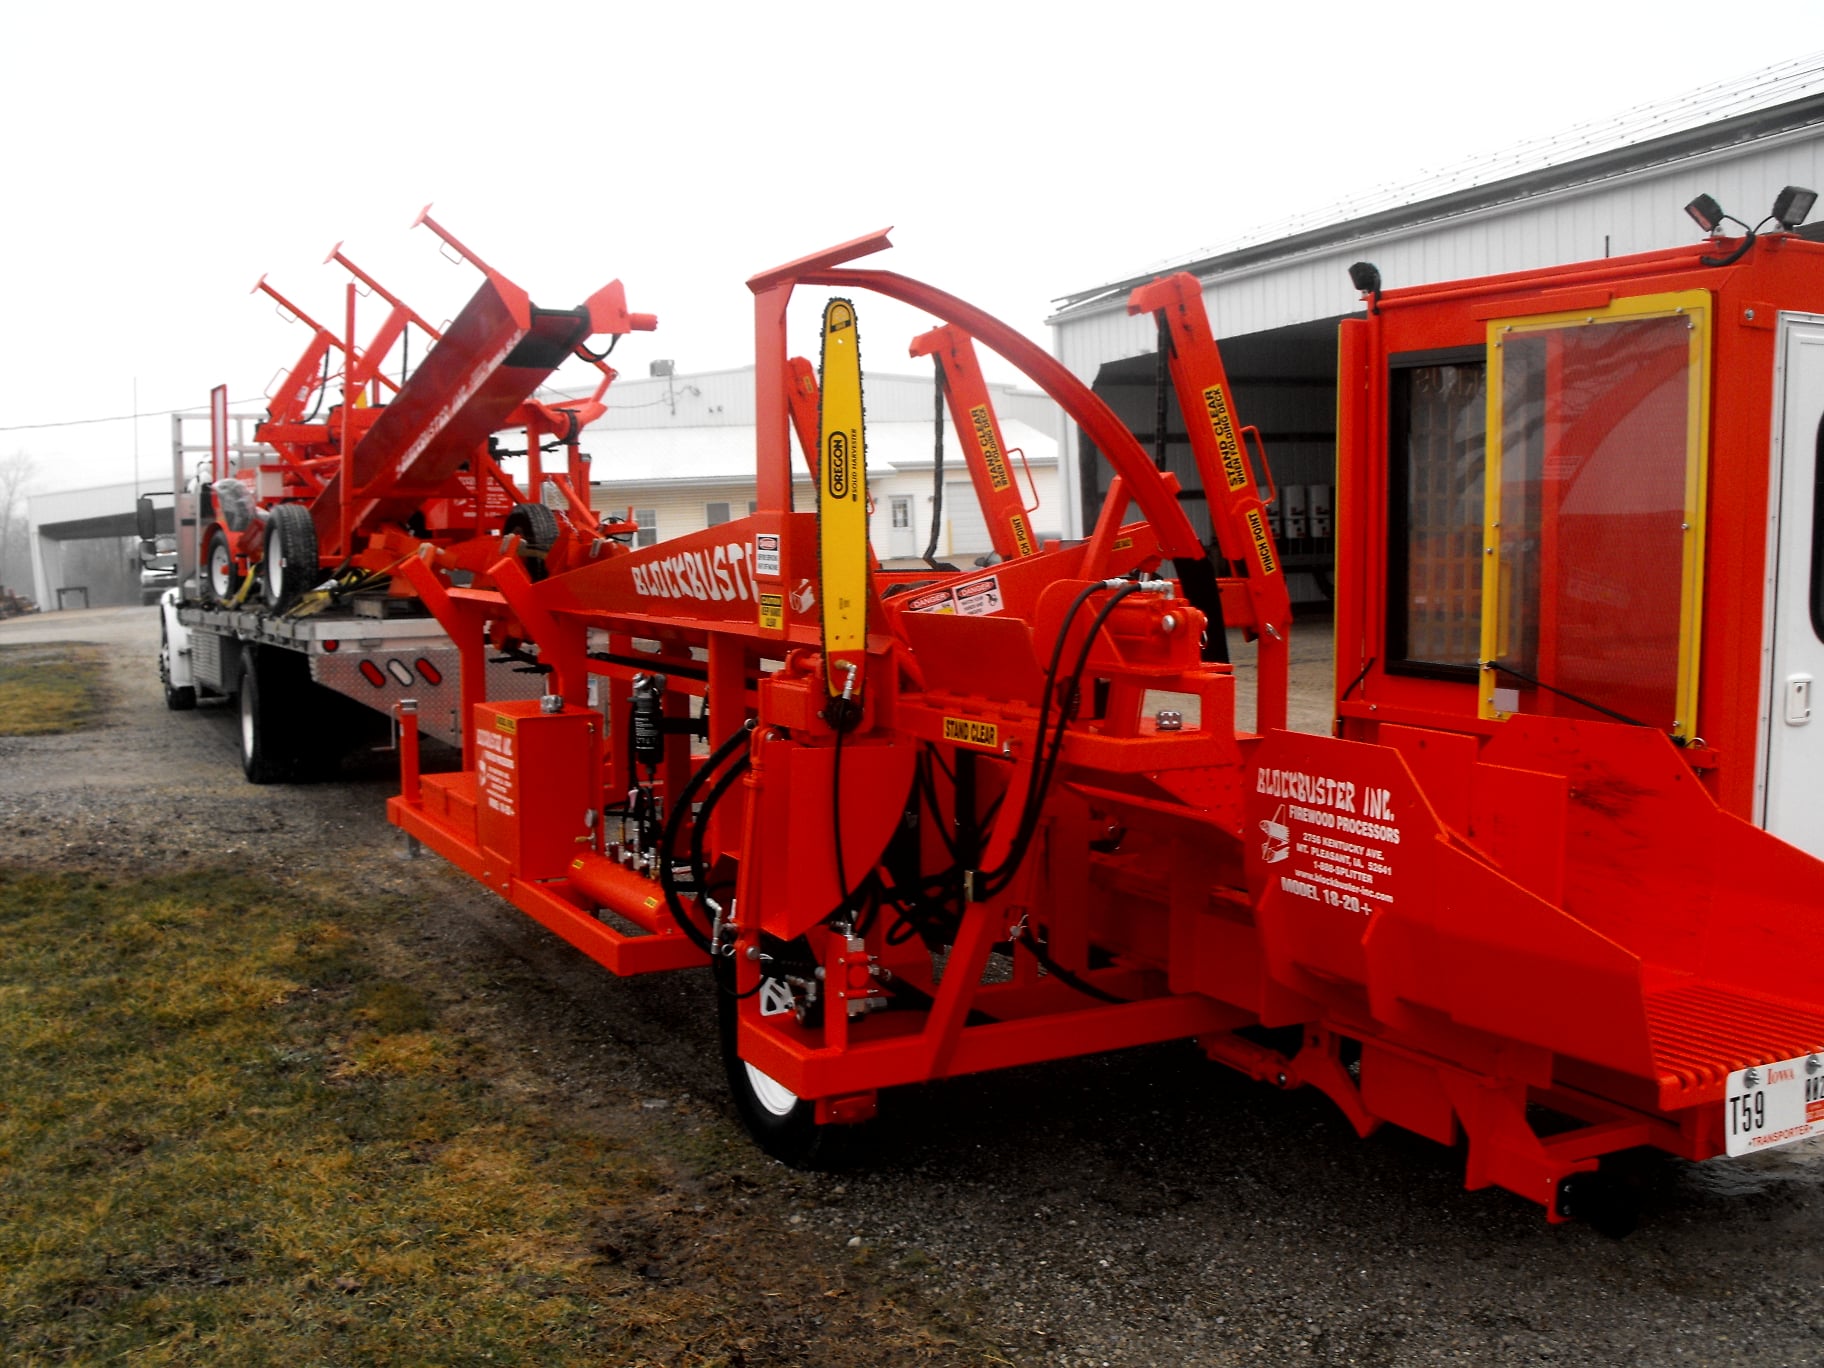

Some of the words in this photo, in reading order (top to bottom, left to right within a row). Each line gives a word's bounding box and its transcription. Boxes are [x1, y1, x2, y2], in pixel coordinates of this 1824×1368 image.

[1205, 390, 1223, 435] CLEAR
[1213, 388, 1226, 413] DECK
[971, 410, 988, 446] CLEAR
[833, 439, 843, 492] OREGON
[984, 450, 1001, 488] STAND
[1220, 441, 1237, 486] STAND
[1233, 458, 1246, 484] WHEN
[1012, 518, 1026, 542] POINT
[1248, 514, 1264, 541] POINT
[1258, 542, 1274, 571] PINCH
[946, 719, 968, 741] STAND
[971, 723, 995, 746] CLEAR
[1256, 767, 1356, 813] BLOCKBUSTER
[1363, 786, 1395, 821] INC.
[1288, 804, 1335, 828] FIREWOOD
[1336, 815, 1401, 845] PROCESSORS
[1322, 837, 1365, 855] KENTUCKY
[1281, 876, 1320, 902] MODEL
[1729, 1090, 1764, 1135] T59
[1752, 1124, 1811, 1147] TRANSPORTER
